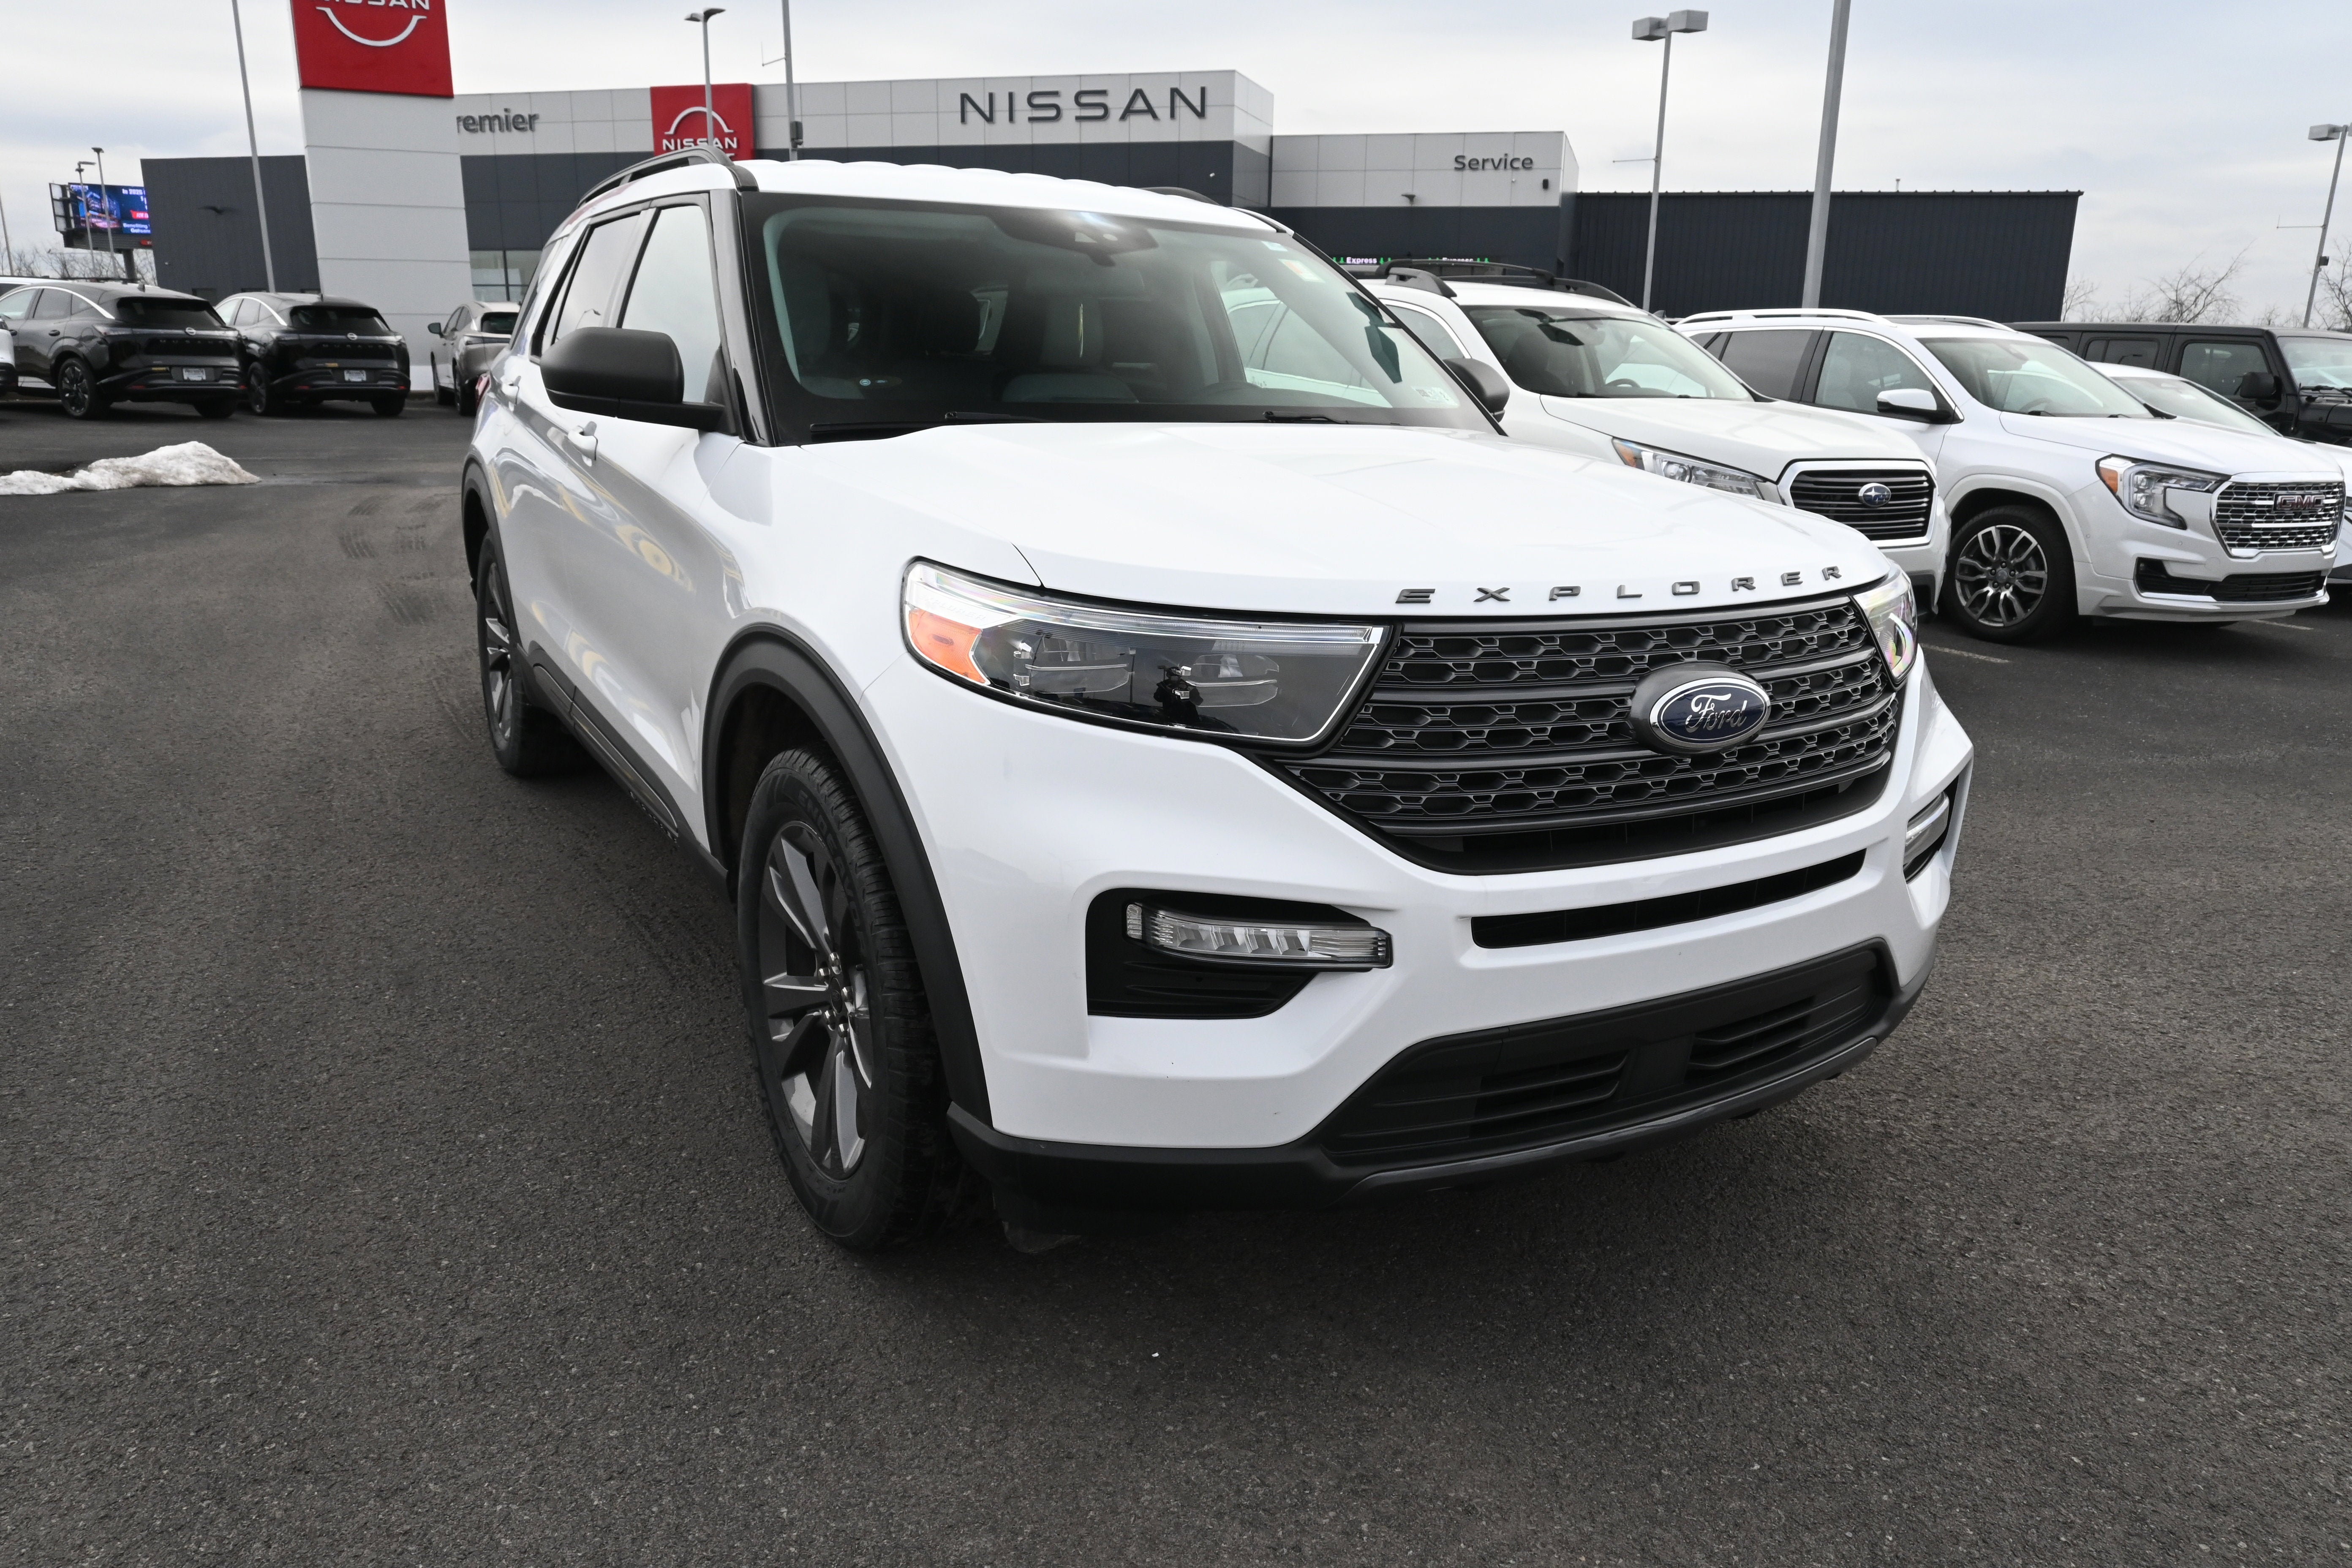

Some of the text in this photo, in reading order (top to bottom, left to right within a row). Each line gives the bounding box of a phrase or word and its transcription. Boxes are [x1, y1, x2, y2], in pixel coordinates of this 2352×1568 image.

[960, 86, 1207, 124] NISSAN
[456, 108, 540, 133] remier
[662, 136, 738, 150] NISSAN
[1454, 154, 1534, 171] Service
[2276, 495, 2325, 510] GMC
[1395, 566, 1843, 604] EXPLORER
[918, 593, 987, 621] EXPLORER
[1685, 693, 1748, 733] Ford
